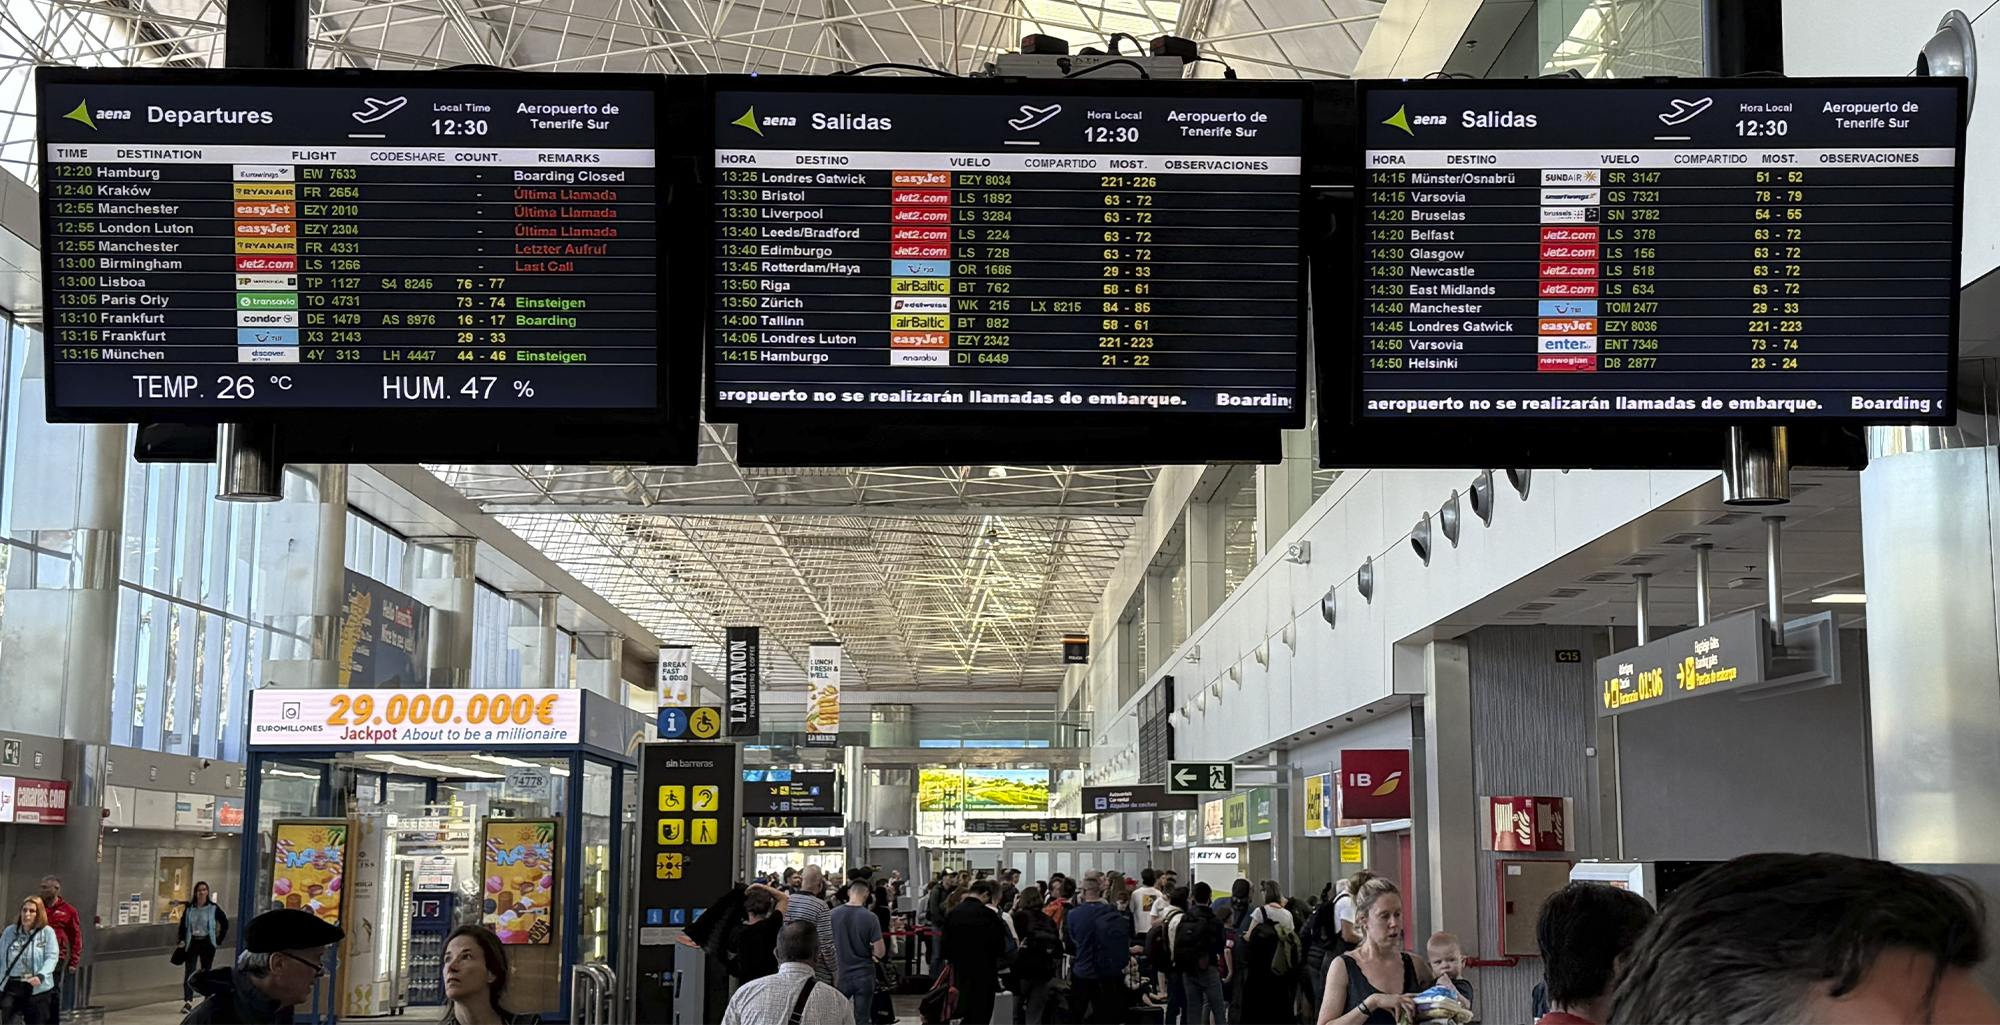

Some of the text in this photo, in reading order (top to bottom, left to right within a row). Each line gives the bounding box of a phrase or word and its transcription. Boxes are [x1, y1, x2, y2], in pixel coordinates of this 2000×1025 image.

[96, 110, 131, 119] aena
[433, 103, 491, 113] Local Time
[517, 103, 619, 116] Aeropuerto de
[1740, 103, 1792, 112] Hora Local
[1823, 101, 1918, 115] Aeropuerto de
[148, 106, 273, 127] Departures
[763, 117, 796, 126] aena
[812, 113, 891, 130] Salidas
[1088, 111, 1142, 119] Hora Local
[1168, 111, 1267, 124] Aeropuerto de
[1413, 116, 1447, 125] aena
[1462, 111, 1537, 128] Salidas
[432, 120, 487, 135] 12:30
[530, 119, 609, 129] Tenerife Sur
[1736, 120, 1787, 136] 12:30
[1836, 118, 1909, 128] Tenerife Sur
[1085, 127, 1138, 142] 12:30
[1180, 126, 1257, 137] Tenerife Sur
[57, 149, 600, 163] TIME DESTINATION FLIGHT CODESHARE COUNT. REMARKS
[721, 155, 1268, 170] HORA DESTINO VUELO COMPARTIDO MOST. OBSERVACIONES
[1373, 154, 1919, 164] HORA DESTINO VUELO COMPARTIDO MOST. OBSERVACIONES
[56, 166, 92, 176] 12:20
[97, 167, 160, 181] Hamburg
[304, 169, 323, 179] EW
[513, 169, 576, 184] Boarding
[579, 171, 624, 181] Closed
[723, 171, 1011, 185] 13:25 Londres Gatwick easyJet EZY 8034
[1372, 172, 1661, 183] 14:15 Münster/Osnabrü SUNDAIR SR 3147
[722, 190, 1012, 203] 13:30 Bristol Jet2.com LS 1892
[1372, 229, 1655, 240] 14:20 Belfast Jet2.com LS 378
[60, 294, 97, 304] 13:05
[102, 294, 135, 304] Paris
[139, 295, 171, 310] Orly
[306, 296, 324, 305] TO
[332, 296, 359, 306] 4731
[516, 297, 586, 311] Einsteigen
[133, 376, 203, 398] TEMP.
[217, 376, 254, 399] 26
[383, 376, 534, 399] HUM. 47 %
[814, 392, 836, 401] no
[842, 392, 864, 401] se
[869, 390, 963, 403] realizarán
[970, 390, 1055, 403] llamadas
[1060, 391, 1082, 404] de
[1088, 392, 1186, 408] embarque.
[1368, 397, 1464, 413] aeropuerto
[1470, 400, 1490, 409] no
[1496, 400, 1516, 409] se
[1523, 397, 1609, 409] realizarán
[1616, 397, 1695, 409] llamadas
[1701, 397, 1723, 409] de
[1729, 396, 1822, 413] embarque.
[1852, 396, 1930, 412] Boarding
[1559, 652, 1578, 660] C15
[1638, 667, 1663, 700] 01:06
[327, 693, 559, 725] 29.000.000€
[340, 726, 567, 744] Jackpot About to be a millionaire
[666, 759, 713, 767] sin barreras
[1350, 773, 1371, 786] IB
